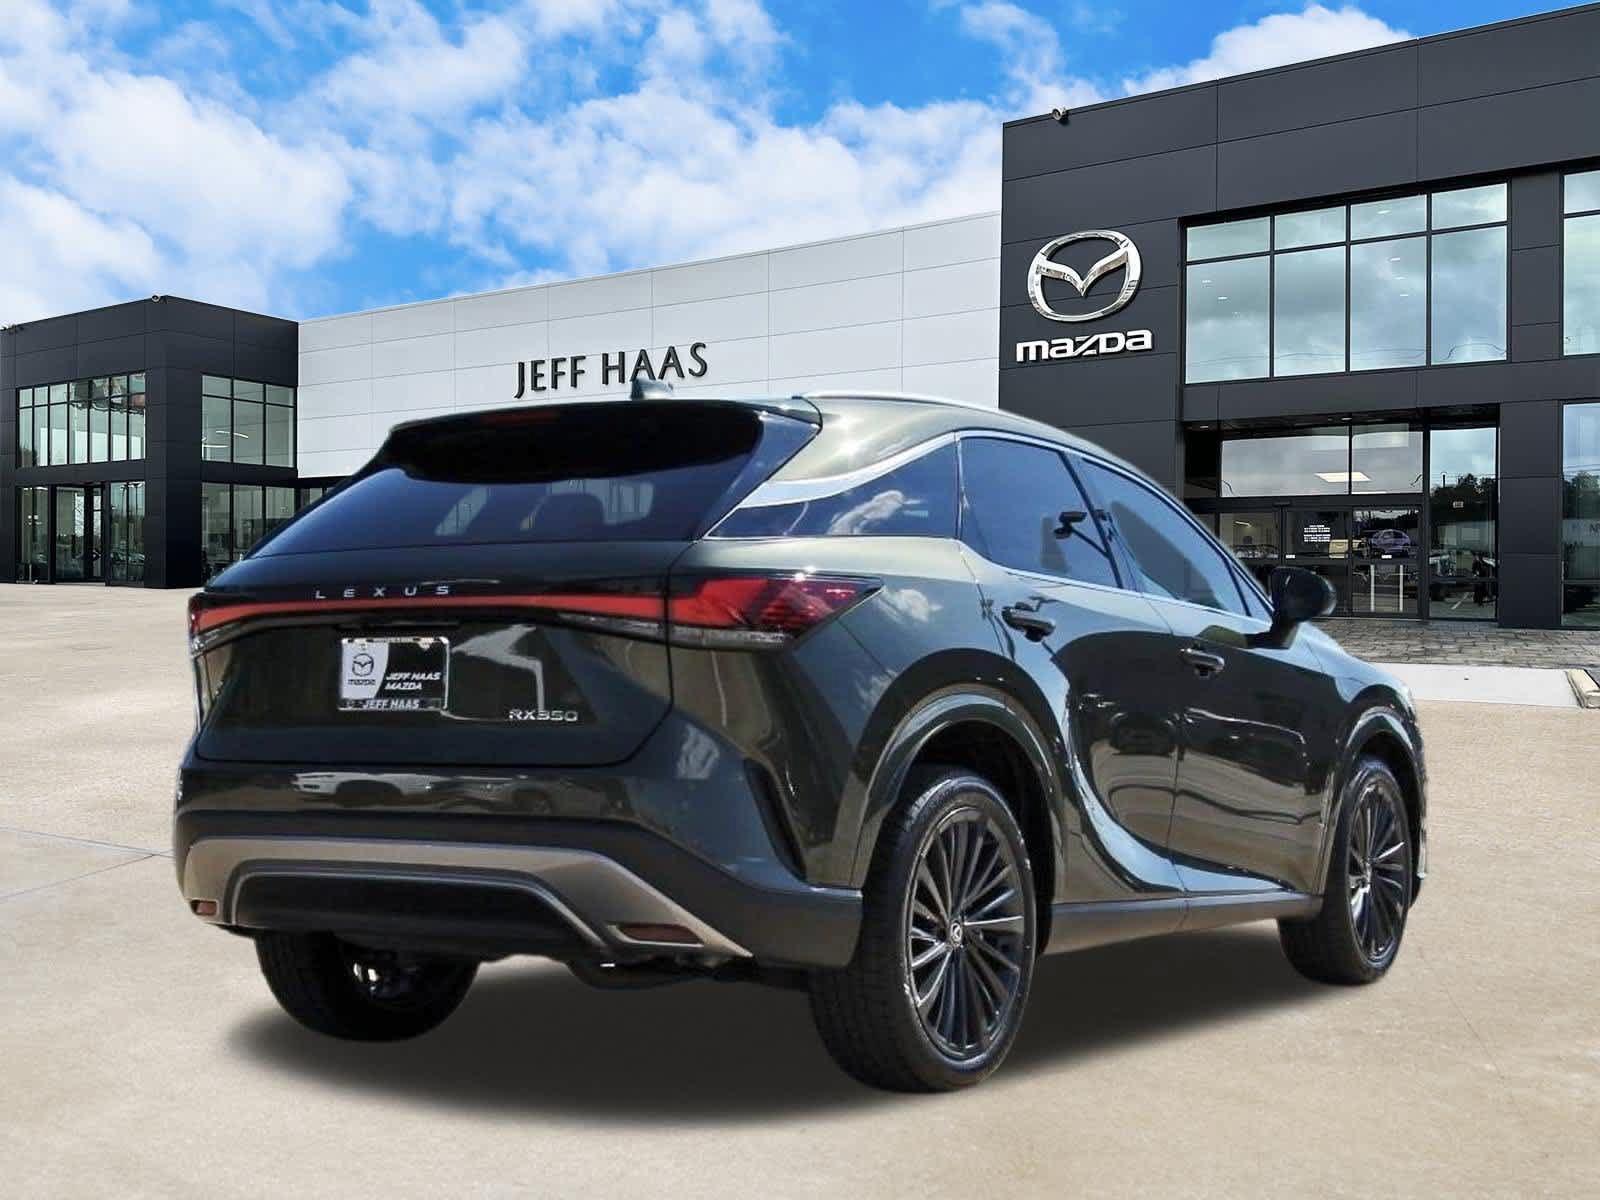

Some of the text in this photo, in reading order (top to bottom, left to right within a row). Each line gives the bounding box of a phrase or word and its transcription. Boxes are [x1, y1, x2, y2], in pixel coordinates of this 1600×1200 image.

[514, 342, 708, 399] JEFF HAAS
[315, 585, 449, 599] LEXUS
[385, 672, 442, 681] JEFF HAAS
[384, 682, 422, 690] MAZDA
[363, 699, 420, 709] JEFF HAAS
